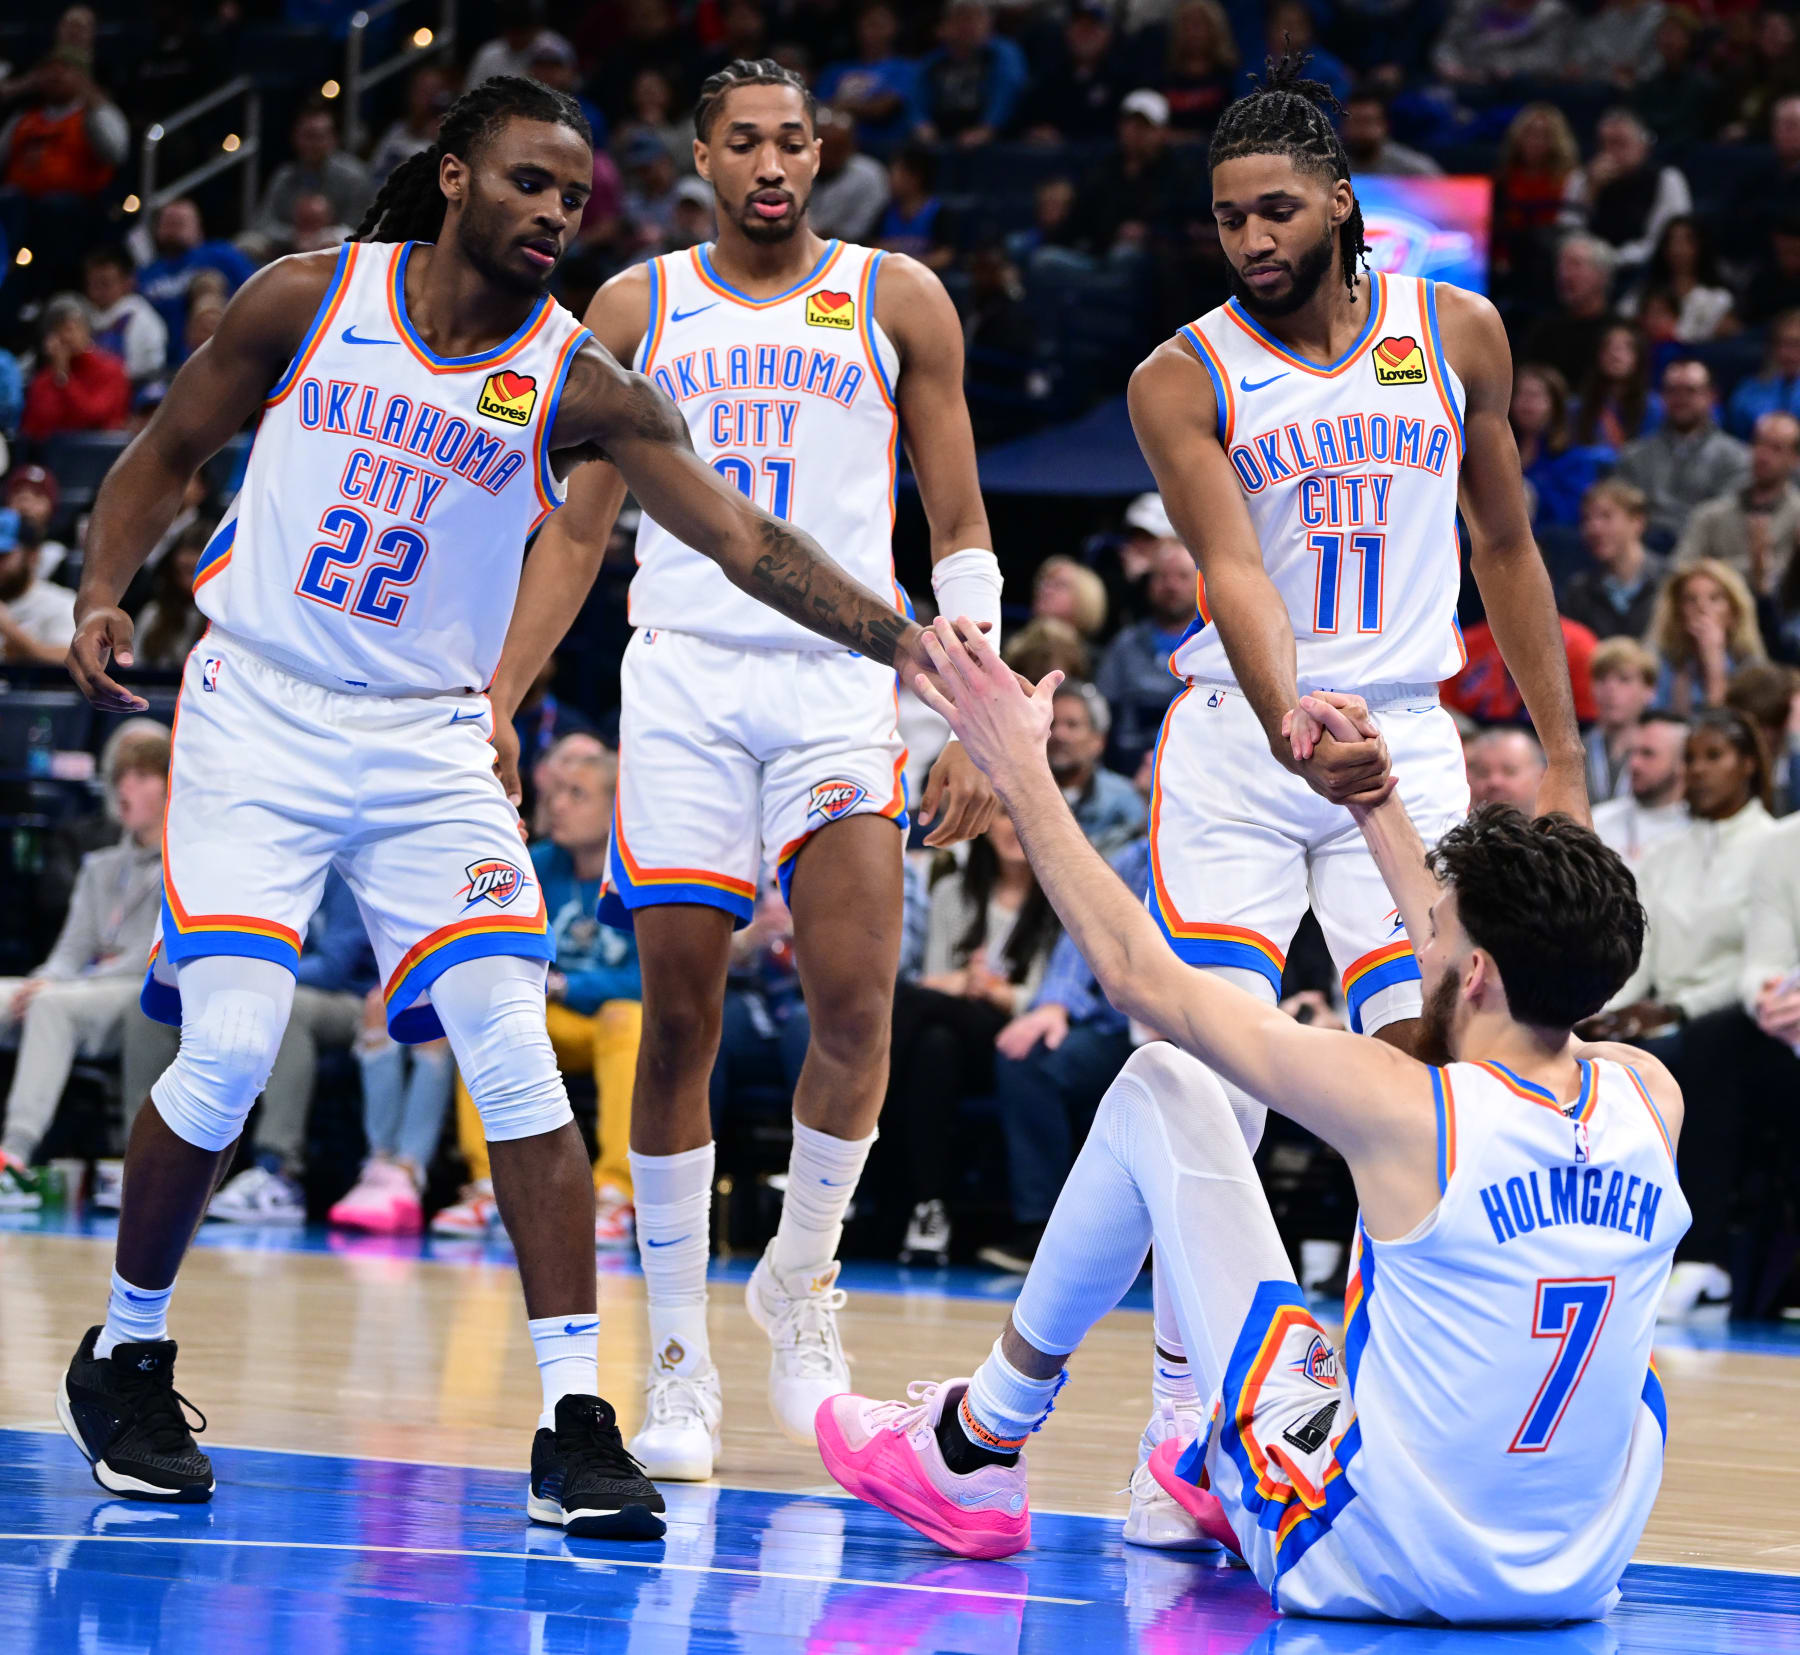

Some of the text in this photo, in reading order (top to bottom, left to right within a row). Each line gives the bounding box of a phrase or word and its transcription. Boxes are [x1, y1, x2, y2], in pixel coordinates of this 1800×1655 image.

[653, 344, 866, 409] OKLAHOMA
[299, 377, 526, 496] OKLAHOMA
[709, 400, 800, 447] CITY
[1229, 413, 1452, 494] OKLAHOMA
[339, 448, 449, 525] CITY
[1299, 474, 1393, 528] CITY
[294, 504, 429, 628] 22
[1307, 531, 1386, 635] 11
[808, 788, 855, 815] OKC
[468, 869, 514, 900] OKC
[1479, 1166, 1663, 1245] HOLMGREN
[1507, 1275, 1616, 1453] 7
